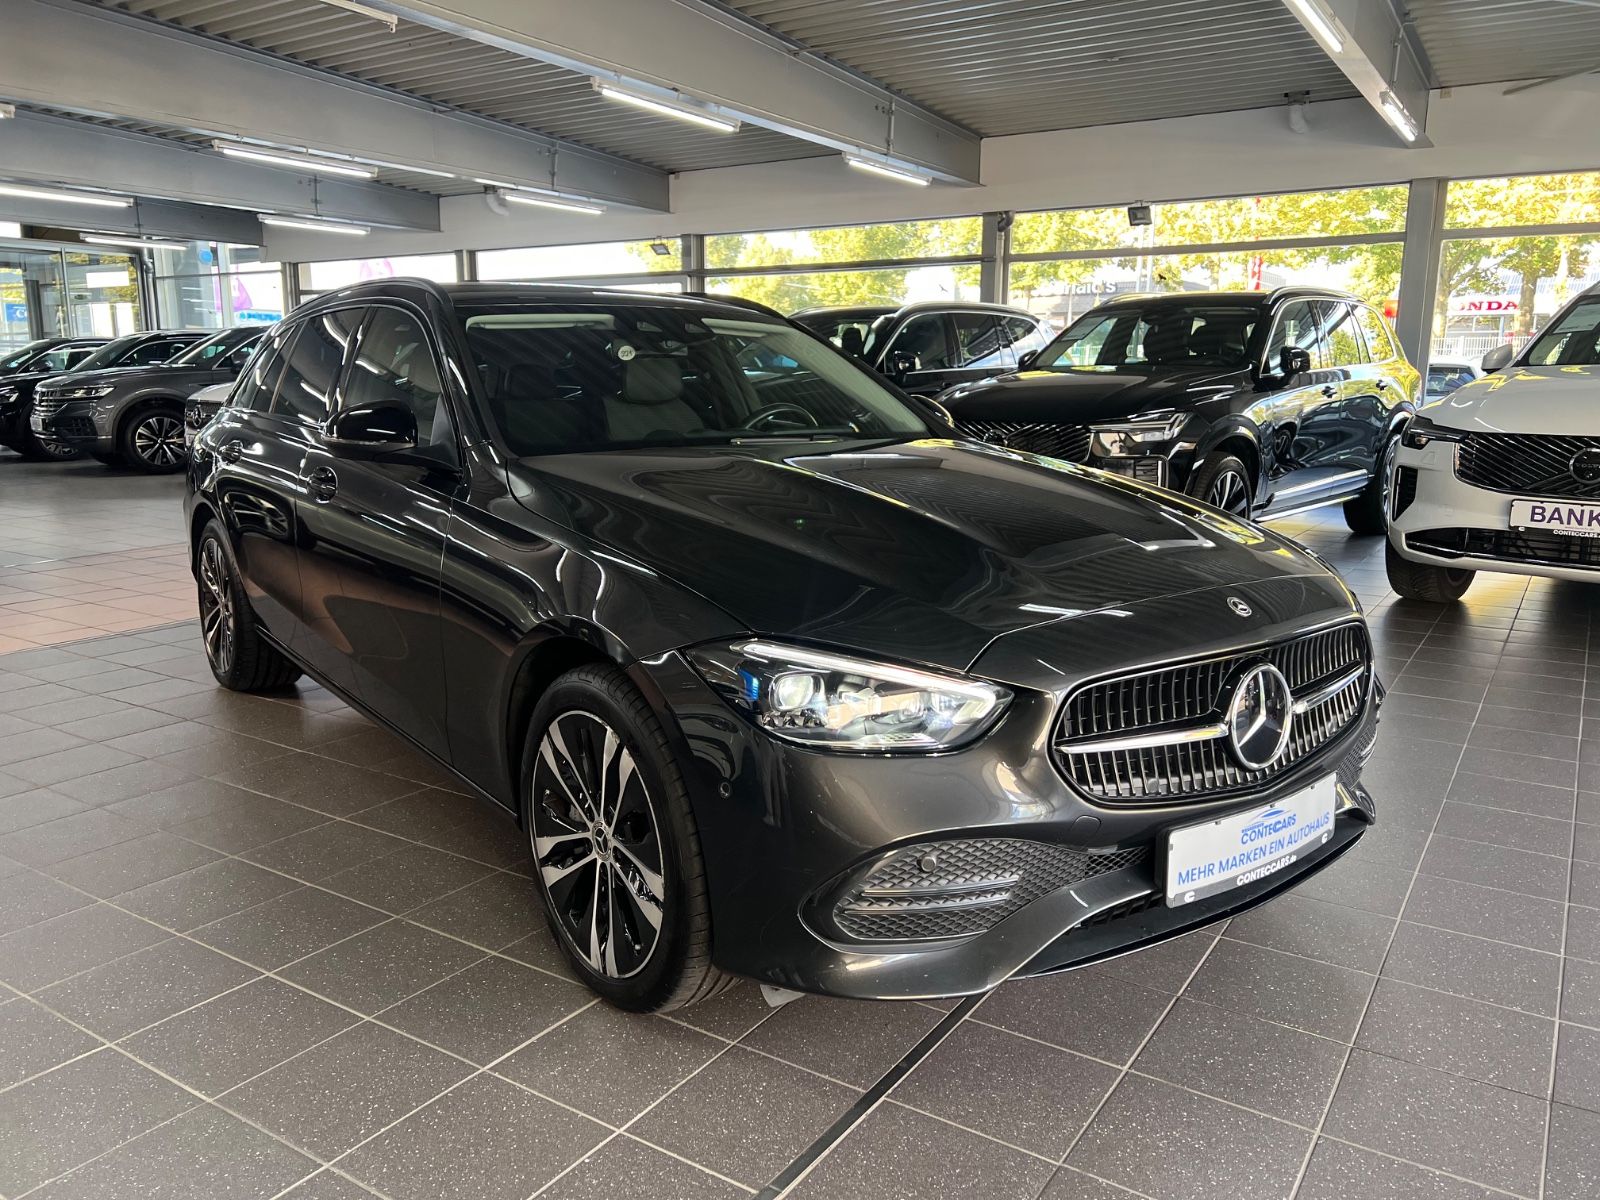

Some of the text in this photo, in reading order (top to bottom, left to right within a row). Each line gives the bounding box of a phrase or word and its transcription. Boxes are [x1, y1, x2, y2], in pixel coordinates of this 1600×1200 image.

[1455, 301, 1520, 311] NDA
[1177, 862, 1215, 886] MEHR
[1218, 846, 1270, 874] MARKEN
[1269, 837, 1285, 856] EIN
[1287, 812, 1330, 846] AUTOHAUS
[1236, 854, 1297, 886] CONTECCARS.de
